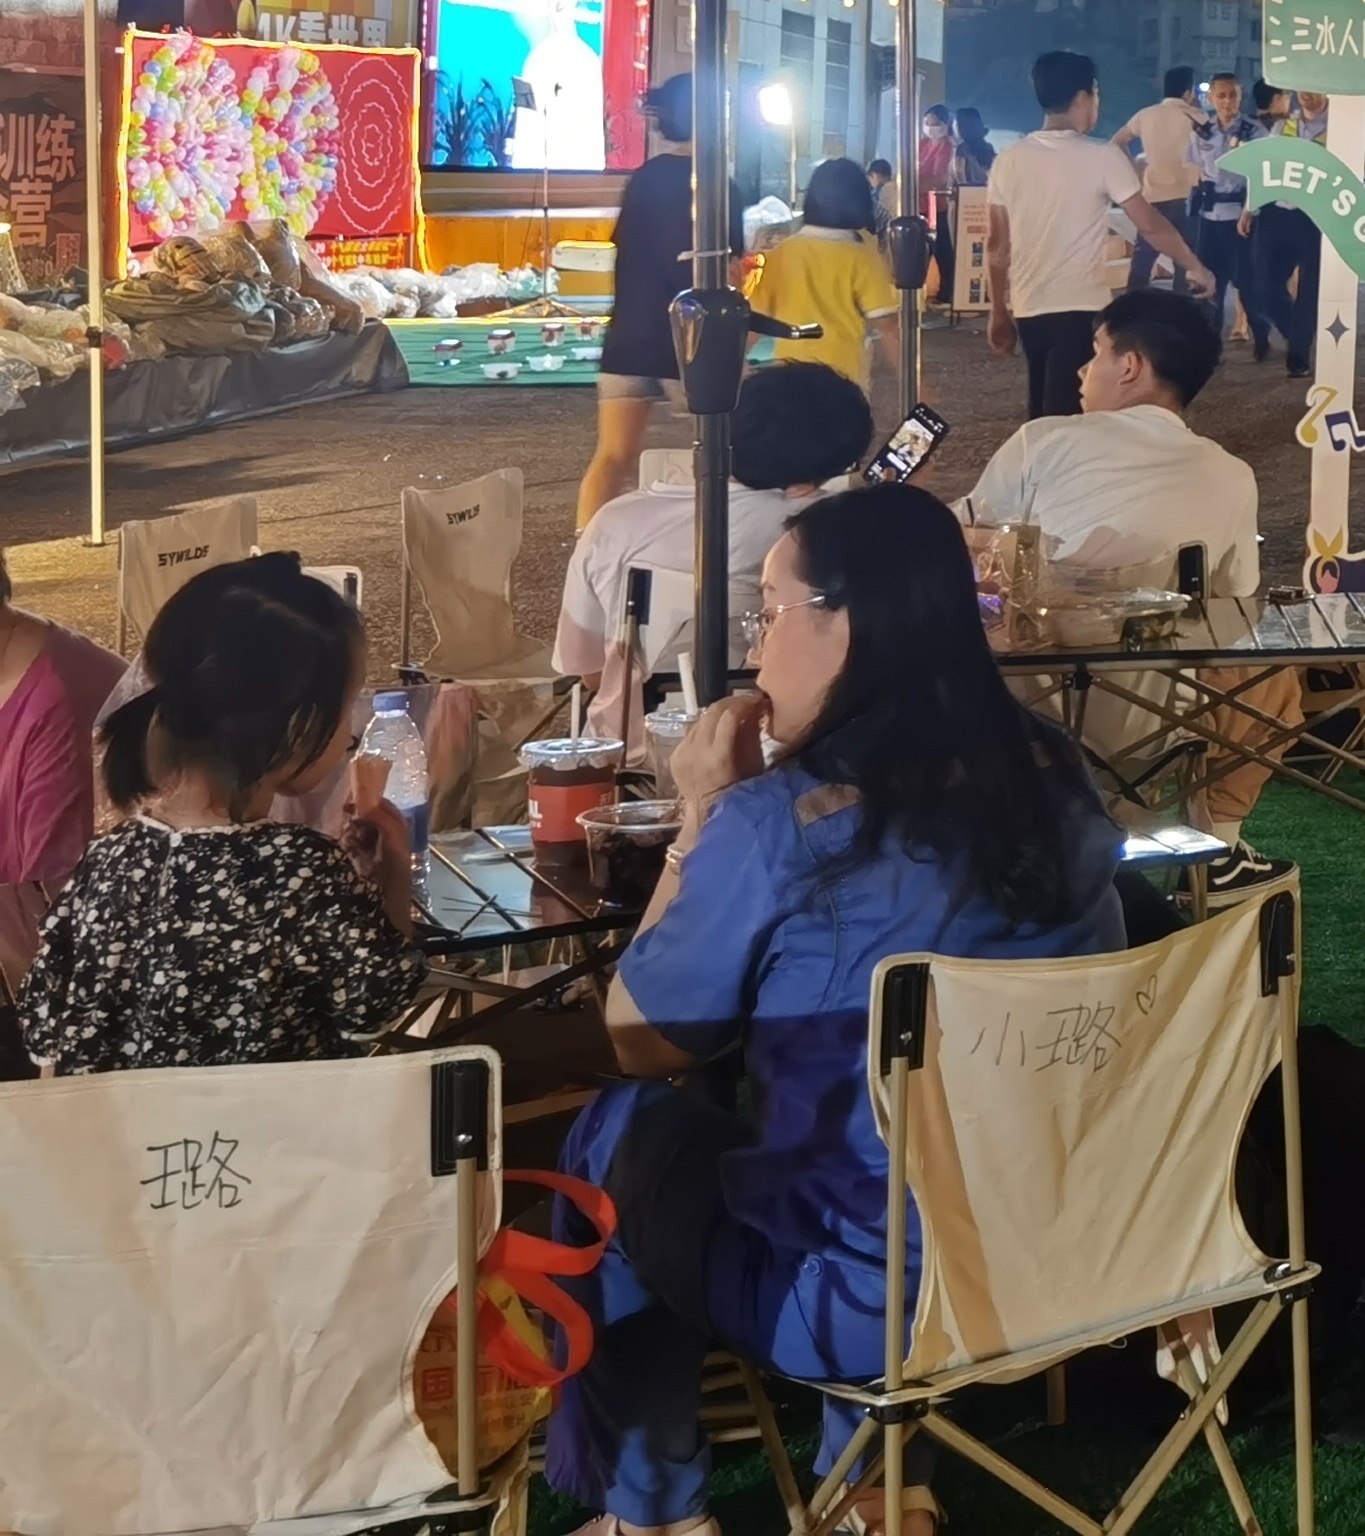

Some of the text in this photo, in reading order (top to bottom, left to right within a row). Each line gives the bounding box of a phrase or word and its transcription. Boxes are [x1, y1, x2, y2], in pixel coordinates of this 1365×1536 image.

[1261, 159, 1358, 217] LET'S
[158, 544, 210, 567] SYWILDS
[970, 1005, 1125, 1074] 小璐
[140, 1130, 252, 1210] 璐
